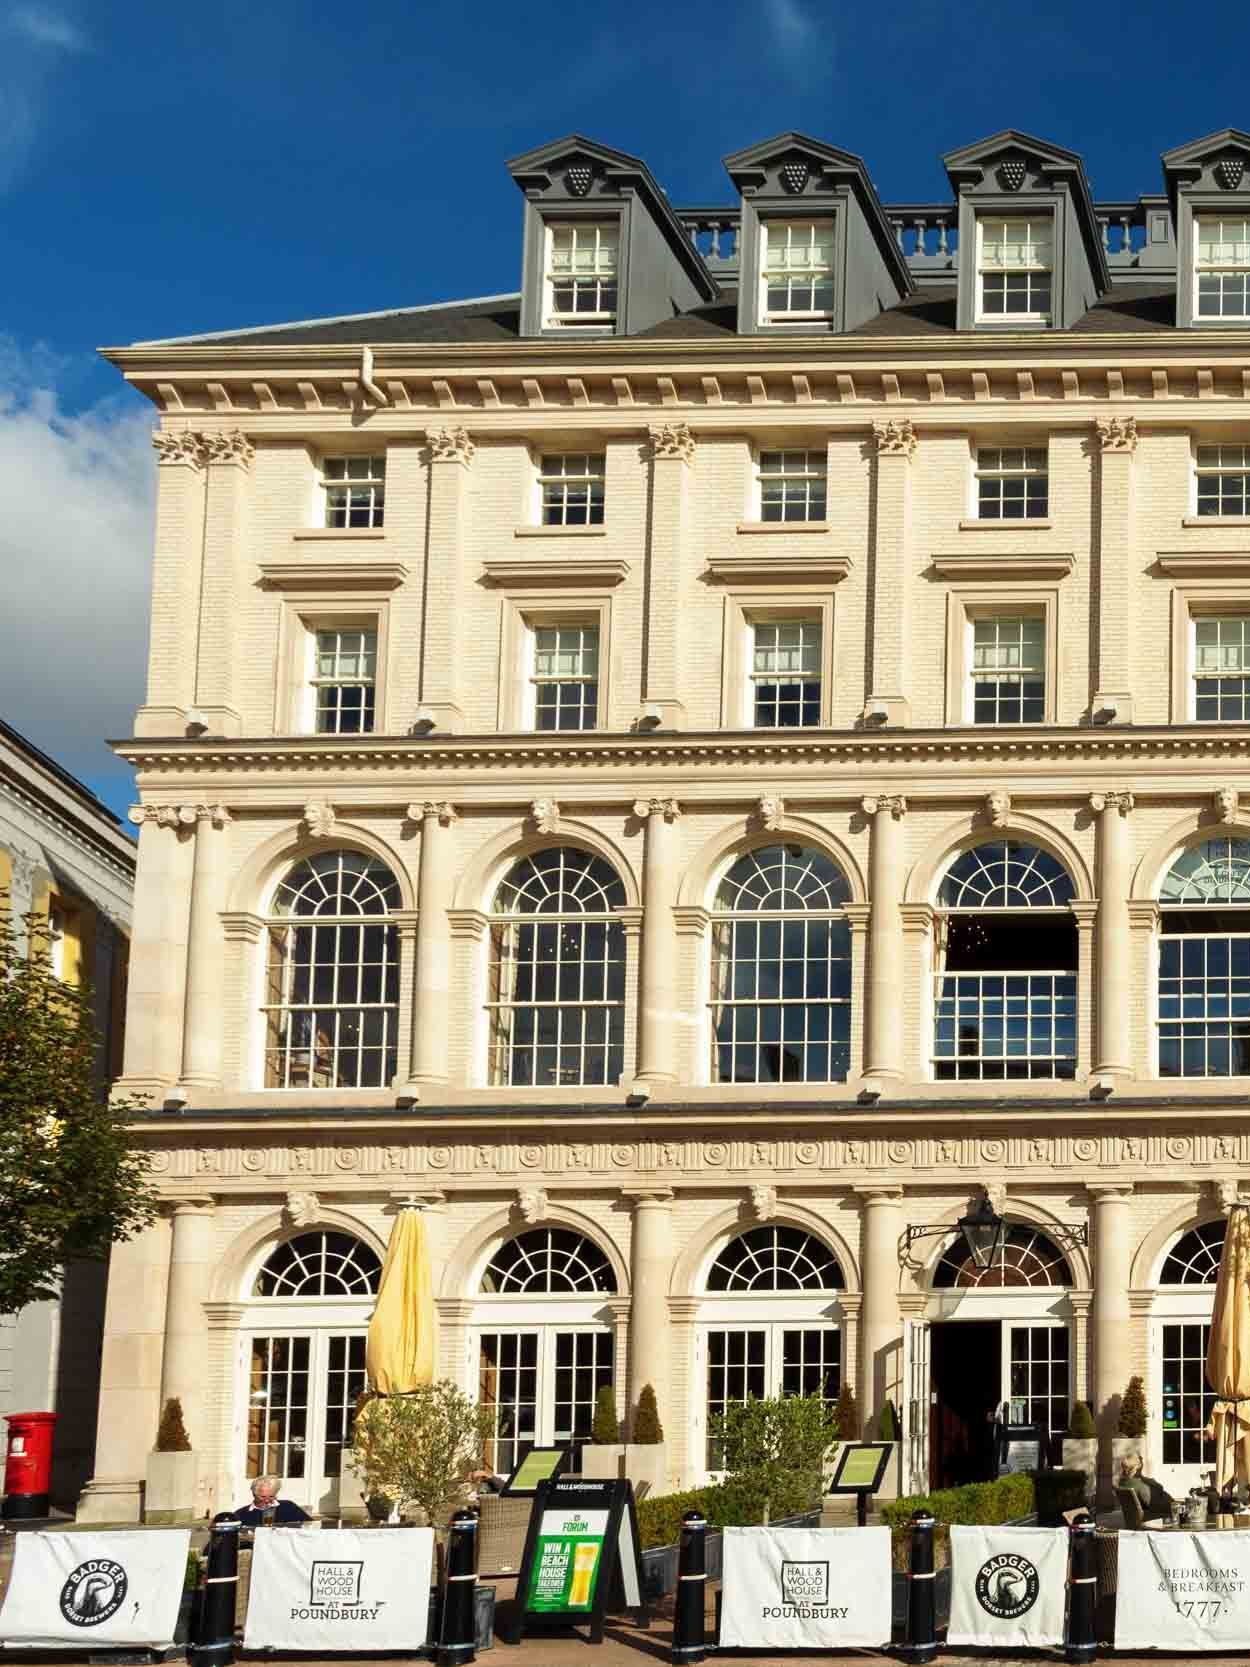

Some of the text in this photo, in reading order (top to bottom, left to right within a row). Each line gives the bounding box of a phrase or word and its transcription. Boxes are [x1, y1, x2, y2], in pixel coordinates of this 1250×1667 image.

[562, 1522, 589, 1532] FORUM
[543, 1542, 571, 1554] WIN A
[542, 1555, 569, 1566] BEACH
[71, 1561, 125, 1584] BADGER
[318, 1567, 354, 1576] HALL &
[540, 1567, 568, 1578] HOUSE
[787, 1567, 823, 1576] HALL &
[982, 1556, 1035, 1578] BADGER
[1164, 1568, 1239, 1579] BEDROOMS
[318, 1577, 354, 1586] WOOD
[787, 1576, 823, 1586] WOOD
[317, 1586, 353, 1596] HOUSE
[787, 1586, 822, 1596] HOUSE
[1158, 1582, 1246, 1593] & BREAKFAST
[800, 1600, 810, 1608] AT
[982, 1596, 1004, 1615] DORSET
[290, 1608, 379, 1620] POUNDBURY
[762, 1607, 849, 1619] POUNDBURY
